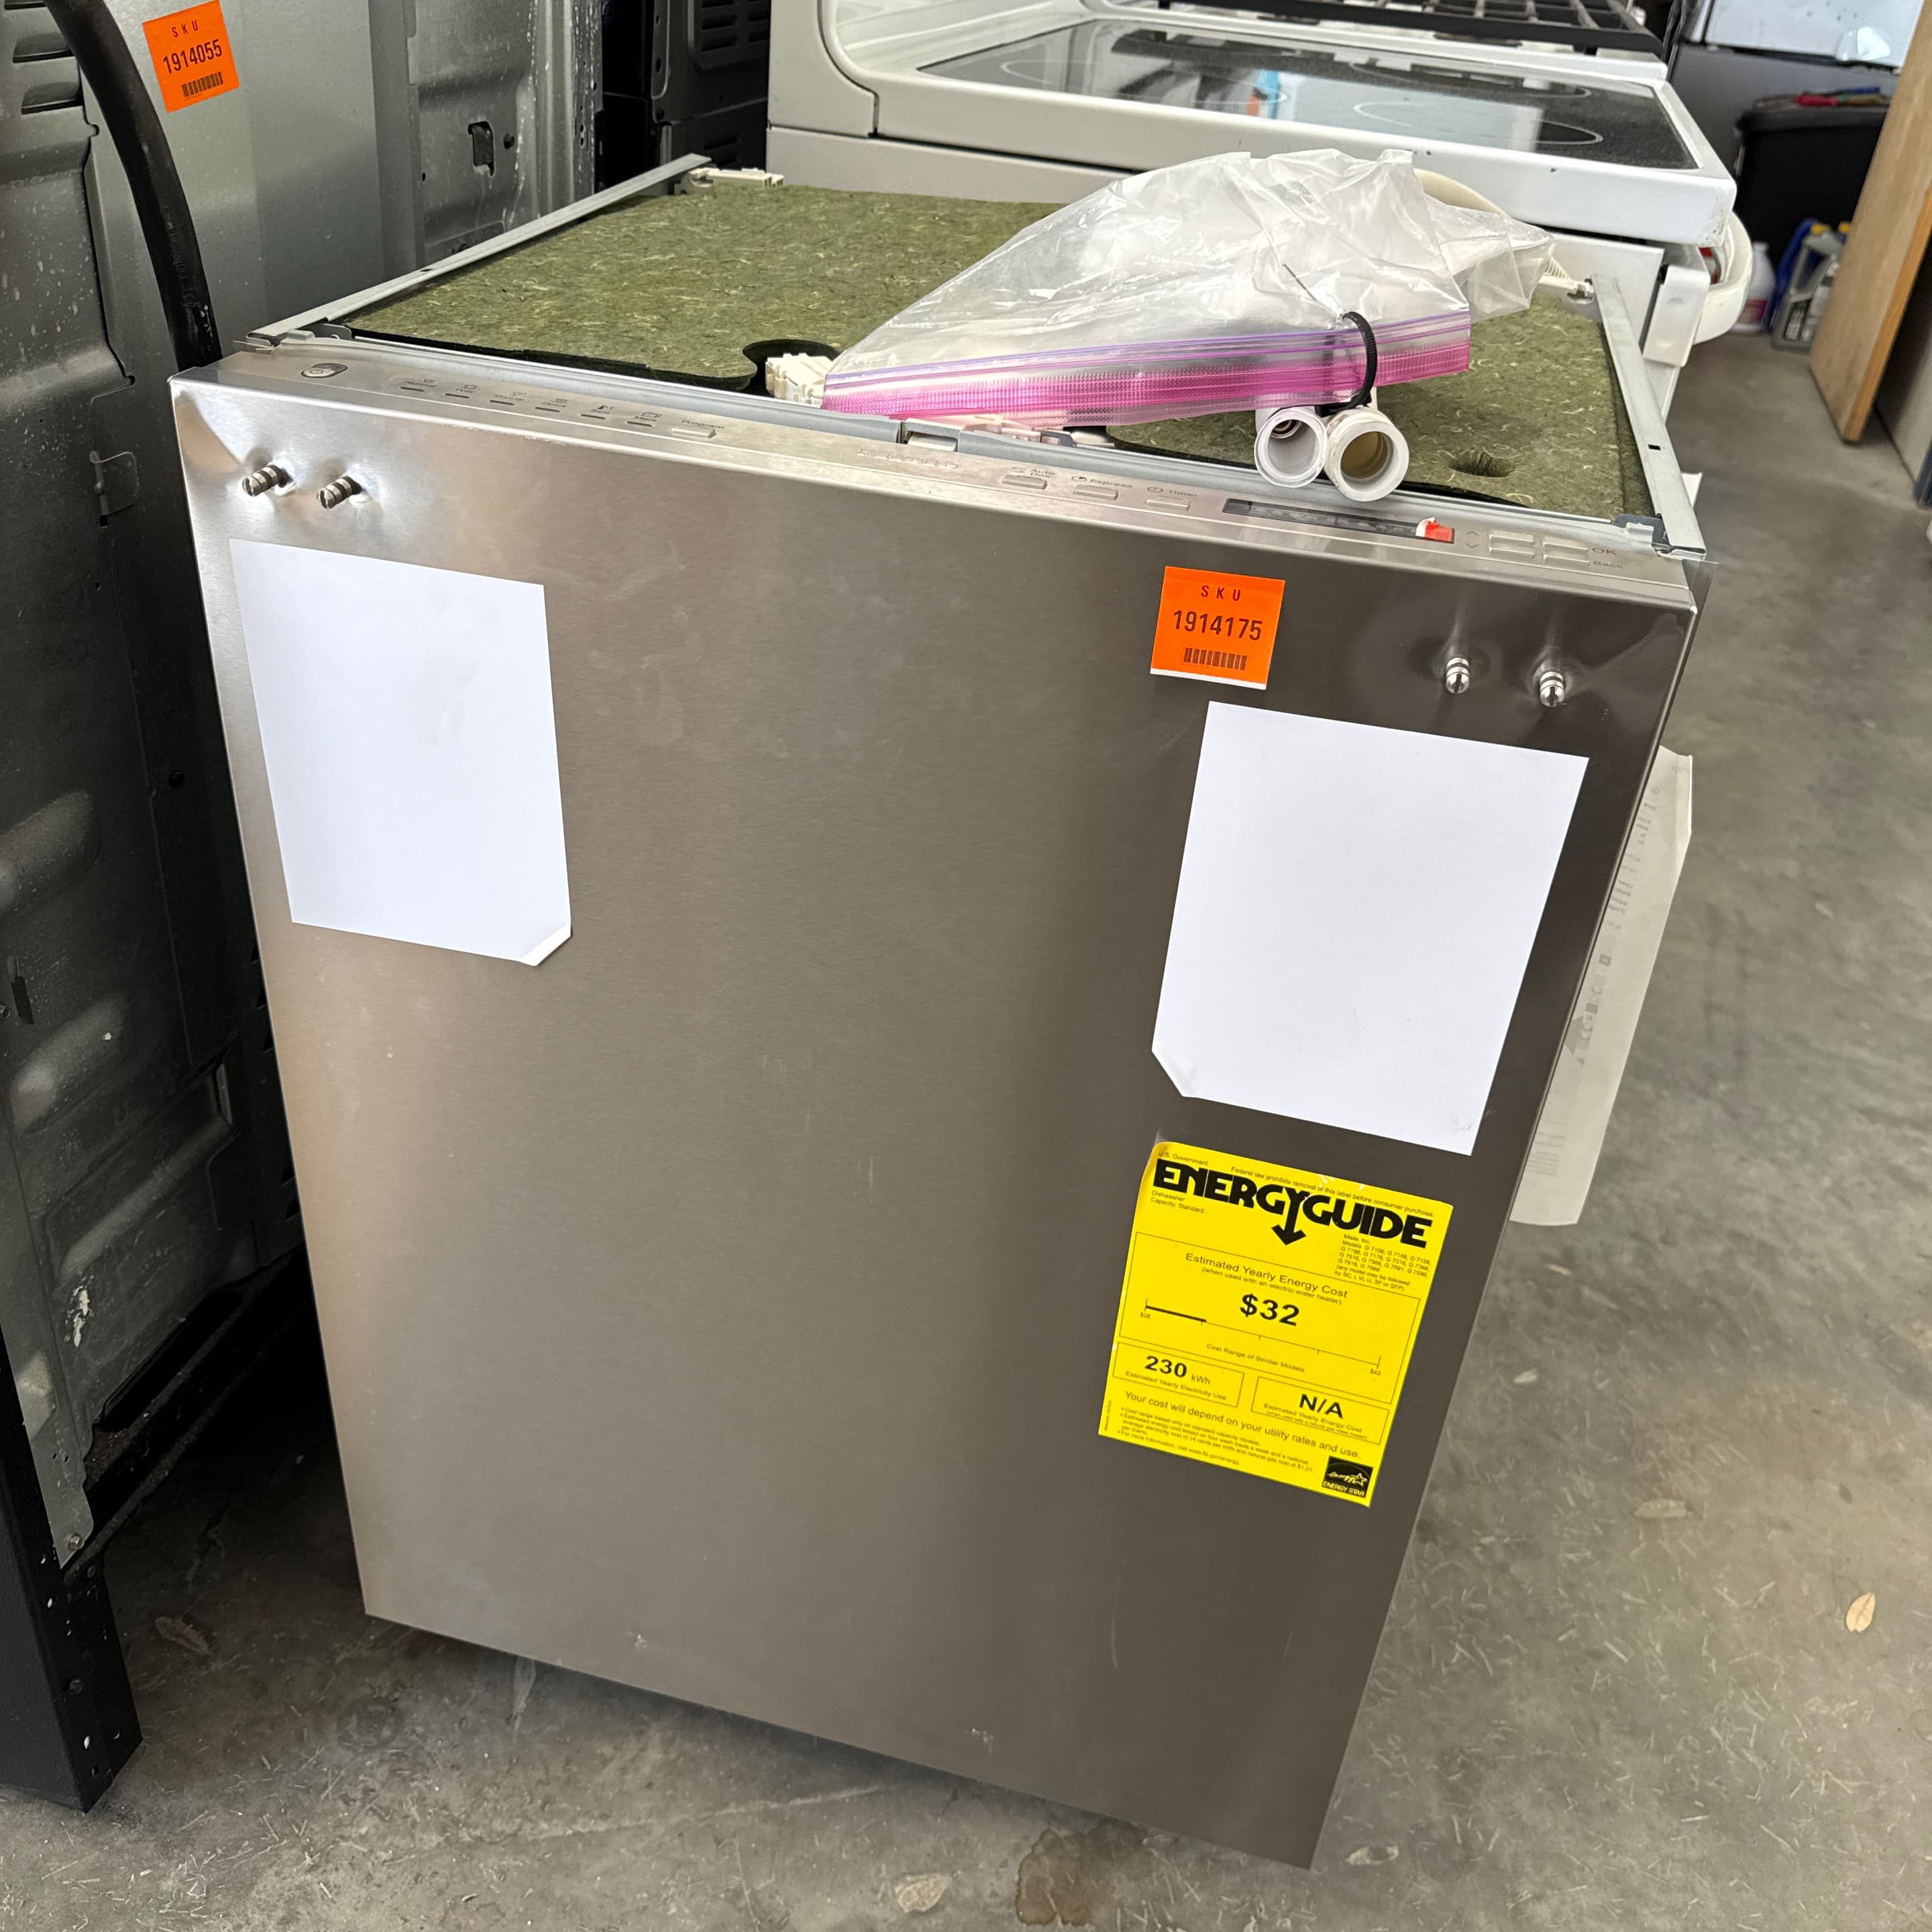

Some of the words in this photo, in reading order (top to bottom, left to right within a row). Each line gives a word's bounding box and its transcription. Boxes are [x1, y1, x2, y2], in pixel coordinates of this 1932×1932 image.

[172, 21, 199, 38] SKU
[163, 39, 222, 74] 1914055
[681, 419, 724, 430] Program
[1089, 478, 1132, 488] Express
[1167, 489, 1198, 497] Timer
[1592, 547, 1617, 555] OK
[1593, 561, 1623, 569] Back
[1201, 586, 1240, 601] SKU
[1174, 610, 1263, 641] 1914175
[1157, 1149, 1169, 1157] U.S.
[1172, 1153, 1208, 1166] Government
[1151, 1189, 1185, 1201] Dishwasher
[1230, 1166, 1253, 1176] Federal
[1265, 1175, 1291, 1185] prohibits
[1291, 1181, 1316, 1190] removal
[1324, 1187, 1336, 1195] this
[1336, 1190, 1351, 1198] label
[1352, 1193, 1372, 1203] before
[1373, 1199, 1403, 1210] consumer
[1153, 1159, 1432, 1248] ENERGYGUIDE
[1178, 1202, 1204, 1214] Standard
[1185, 1252, 1239, 1272] Estimated
[1242, 1265, 1276, 1282] Yearly
[1279, 1274, 1318, 1292] Energy
[1321, 1285, 1347, 1298] Cost
[1201, 1267, 1223, 1276] (when
[1224, 1273, 1242, 1281] used
[1269, 1283, 1294, 1293] electric
[1295, 1289, 1315, 1297] water
[1316, 1293, 1342, 1305] heater)
[1240, 1293, 1299, 1326] $32
[1144, 1355, 1187, 1377] 230
[1191, 1373, 1210, 1385] kWh
[1206, 1343, 1222, 1352] Cost
[1223, 1347, 1245, 1358] Range
[1255, 1355, 1279, 1365] Similar
[1279, 1361, 1305, 1372] Models
[1125, 1371, 1157, 1383] Estimated
[1159, 1379, 1179, 1389] Yearly
[1180, 1384, 1212, 1397] Electricity
[1212, 1392, 1226, 1400] Use
[1263, 1402, 1297, 1415] Estimated
[1298, 1411, 1319, 1422] Yearly
[1320, 1417, 1344, 1429] Energy
[1345, 1424, 1362, 1433] Cost
[1299, 1393, 1342, 1418] N/A
[1125, 1390, 1146, 1403] Your
[1148, 1398, 1168, 1409] cost
[1170, 1403, 1185, 1413] will
[1187, 1407, 1224, 1422] depend
[1225, 1417, 1238, 1426] on
[1240, 1421, 1263, 1432] your
[1264, 1428, 1289, 1441] utility
[1291, 1435, 1316, 1446] rates
[1318, 1442, 1338, 1452] and
[1322, 1481, 1348, 1491] ENERGY
[1348, 1487, 1364, 1496] STAR
